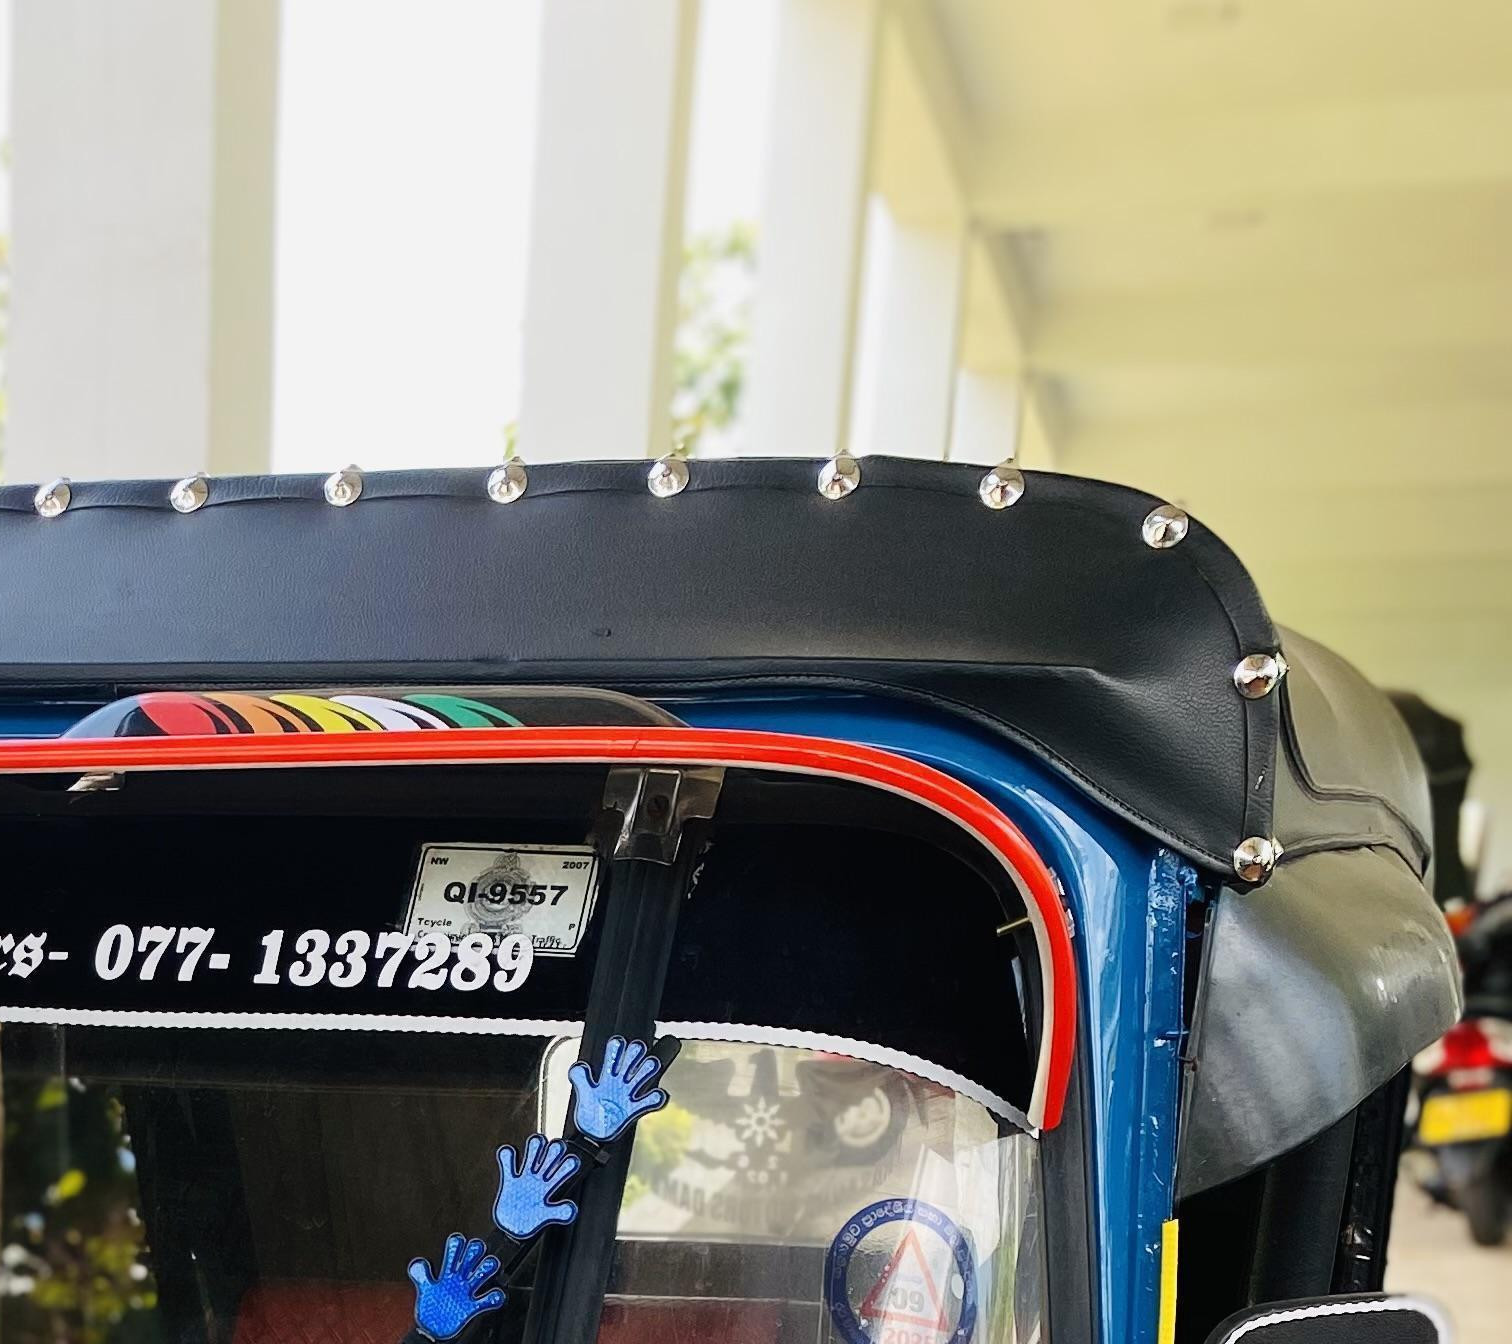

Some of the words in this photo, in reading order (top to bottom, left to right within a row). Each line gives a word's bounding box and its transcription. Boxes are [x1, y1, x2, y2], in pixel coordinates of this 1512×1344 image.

[430, 856, 450, 867] NW
[562, 860, 590, 871] 2007
[443, 881, 569, 907] QI-9557
[417, 917, 453, 928] Tcycle
[94, 924, 231, 981] 077-
[253, 929, 535, 993] 1337289
